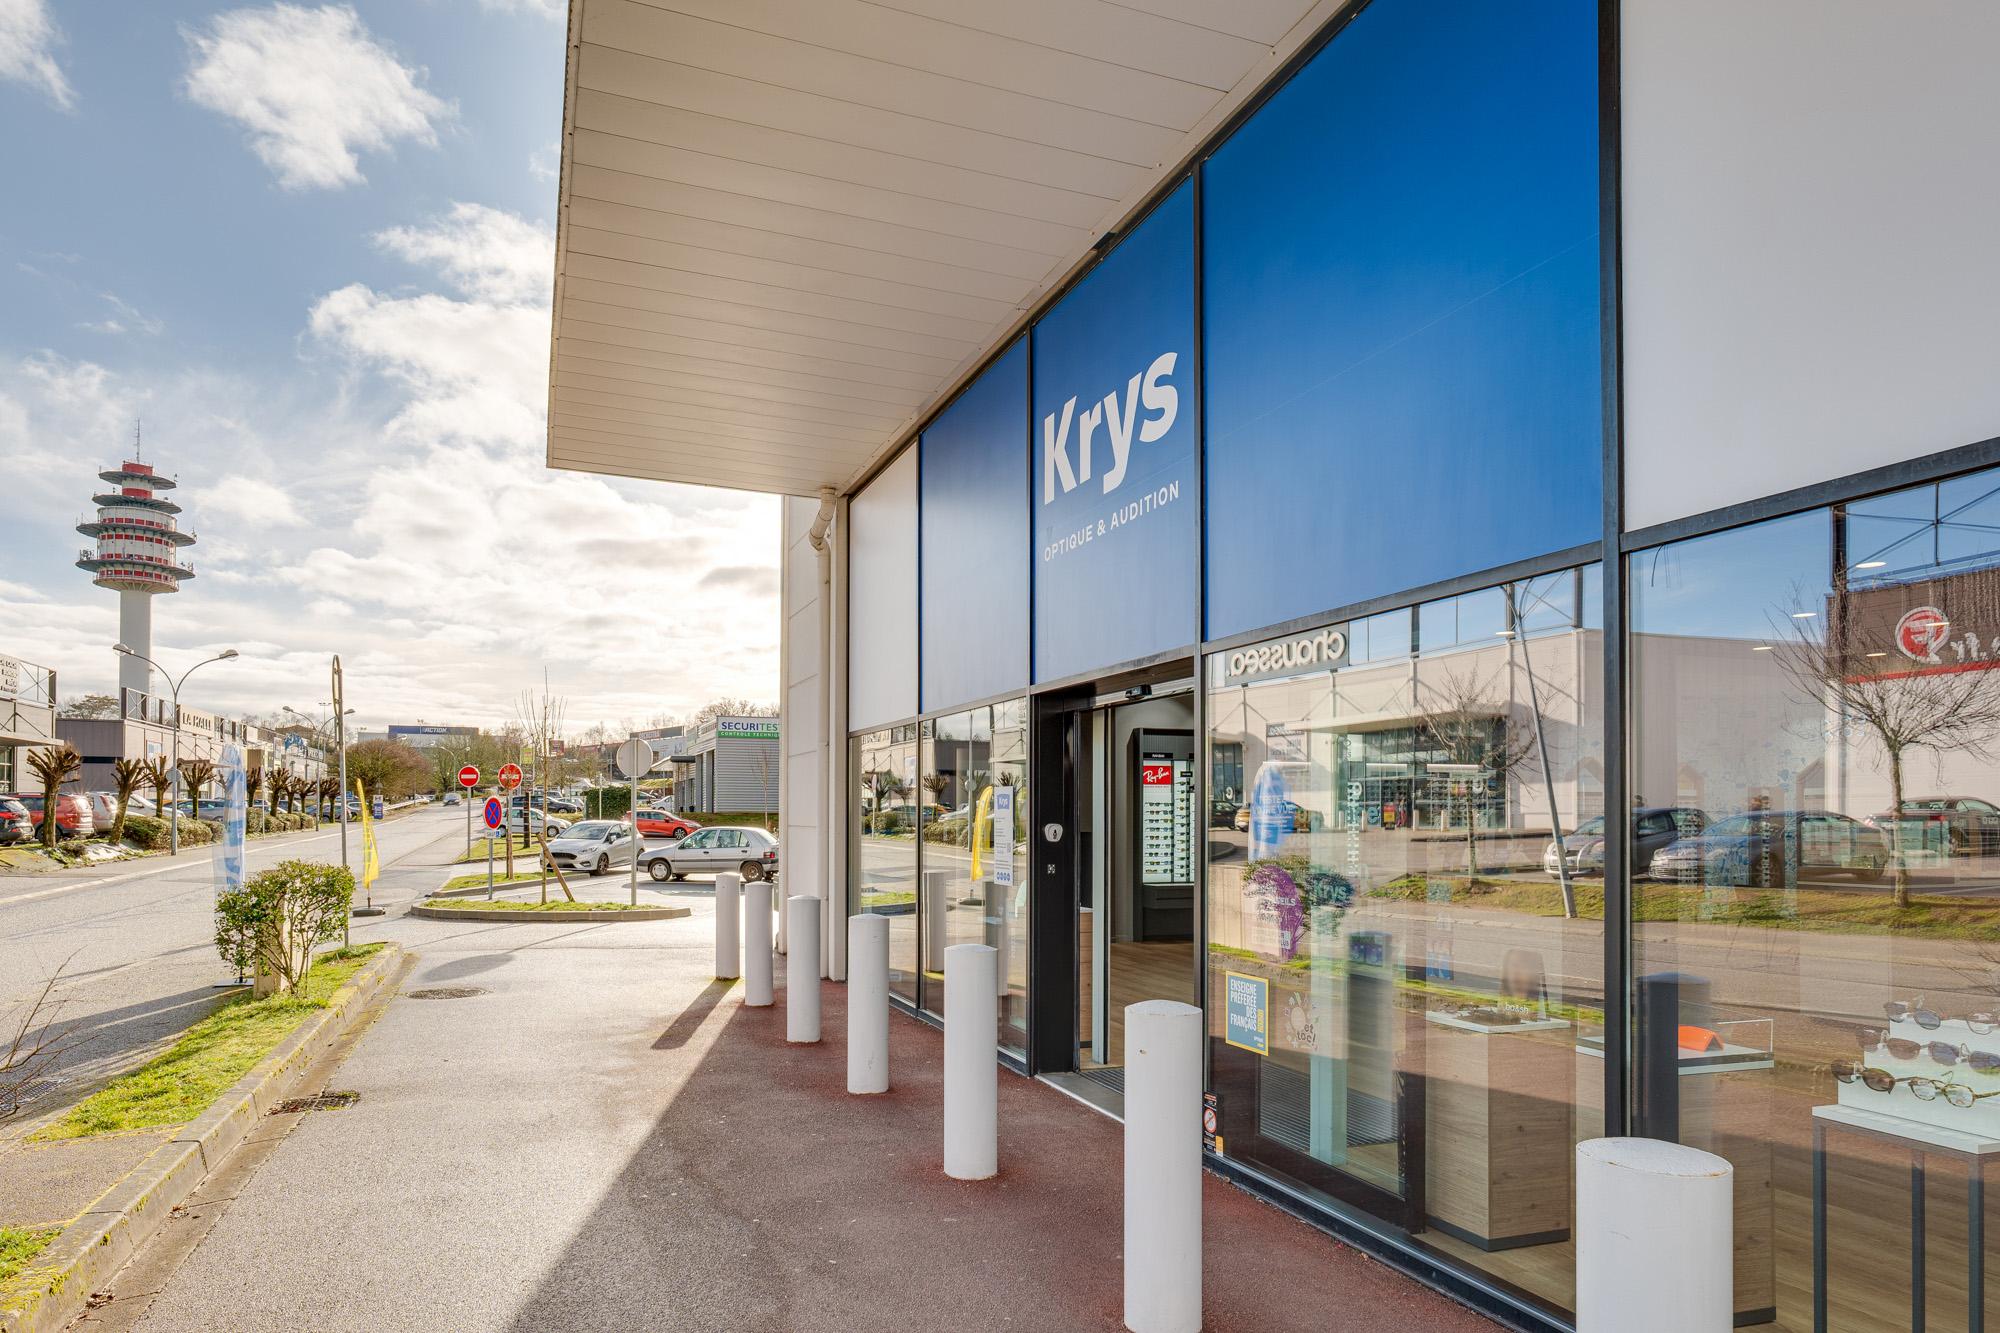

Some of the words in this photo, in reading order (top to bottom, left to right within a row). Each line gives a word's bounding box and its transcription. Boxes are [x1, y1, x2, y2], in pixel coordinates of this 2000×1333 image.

[1044, 352, 1178, 505] Krys
[1044, 525, 1093, 562] OPTIQUE
[1097, 519, 1106, 537] &
[1110, 480, 1180, 531] AUDITION
[721, 721, 780, 731] SECURITES
[1230, 979, 1257, 996] ENSEIGNE
[1245, 1006, 1257, 1019] DES
